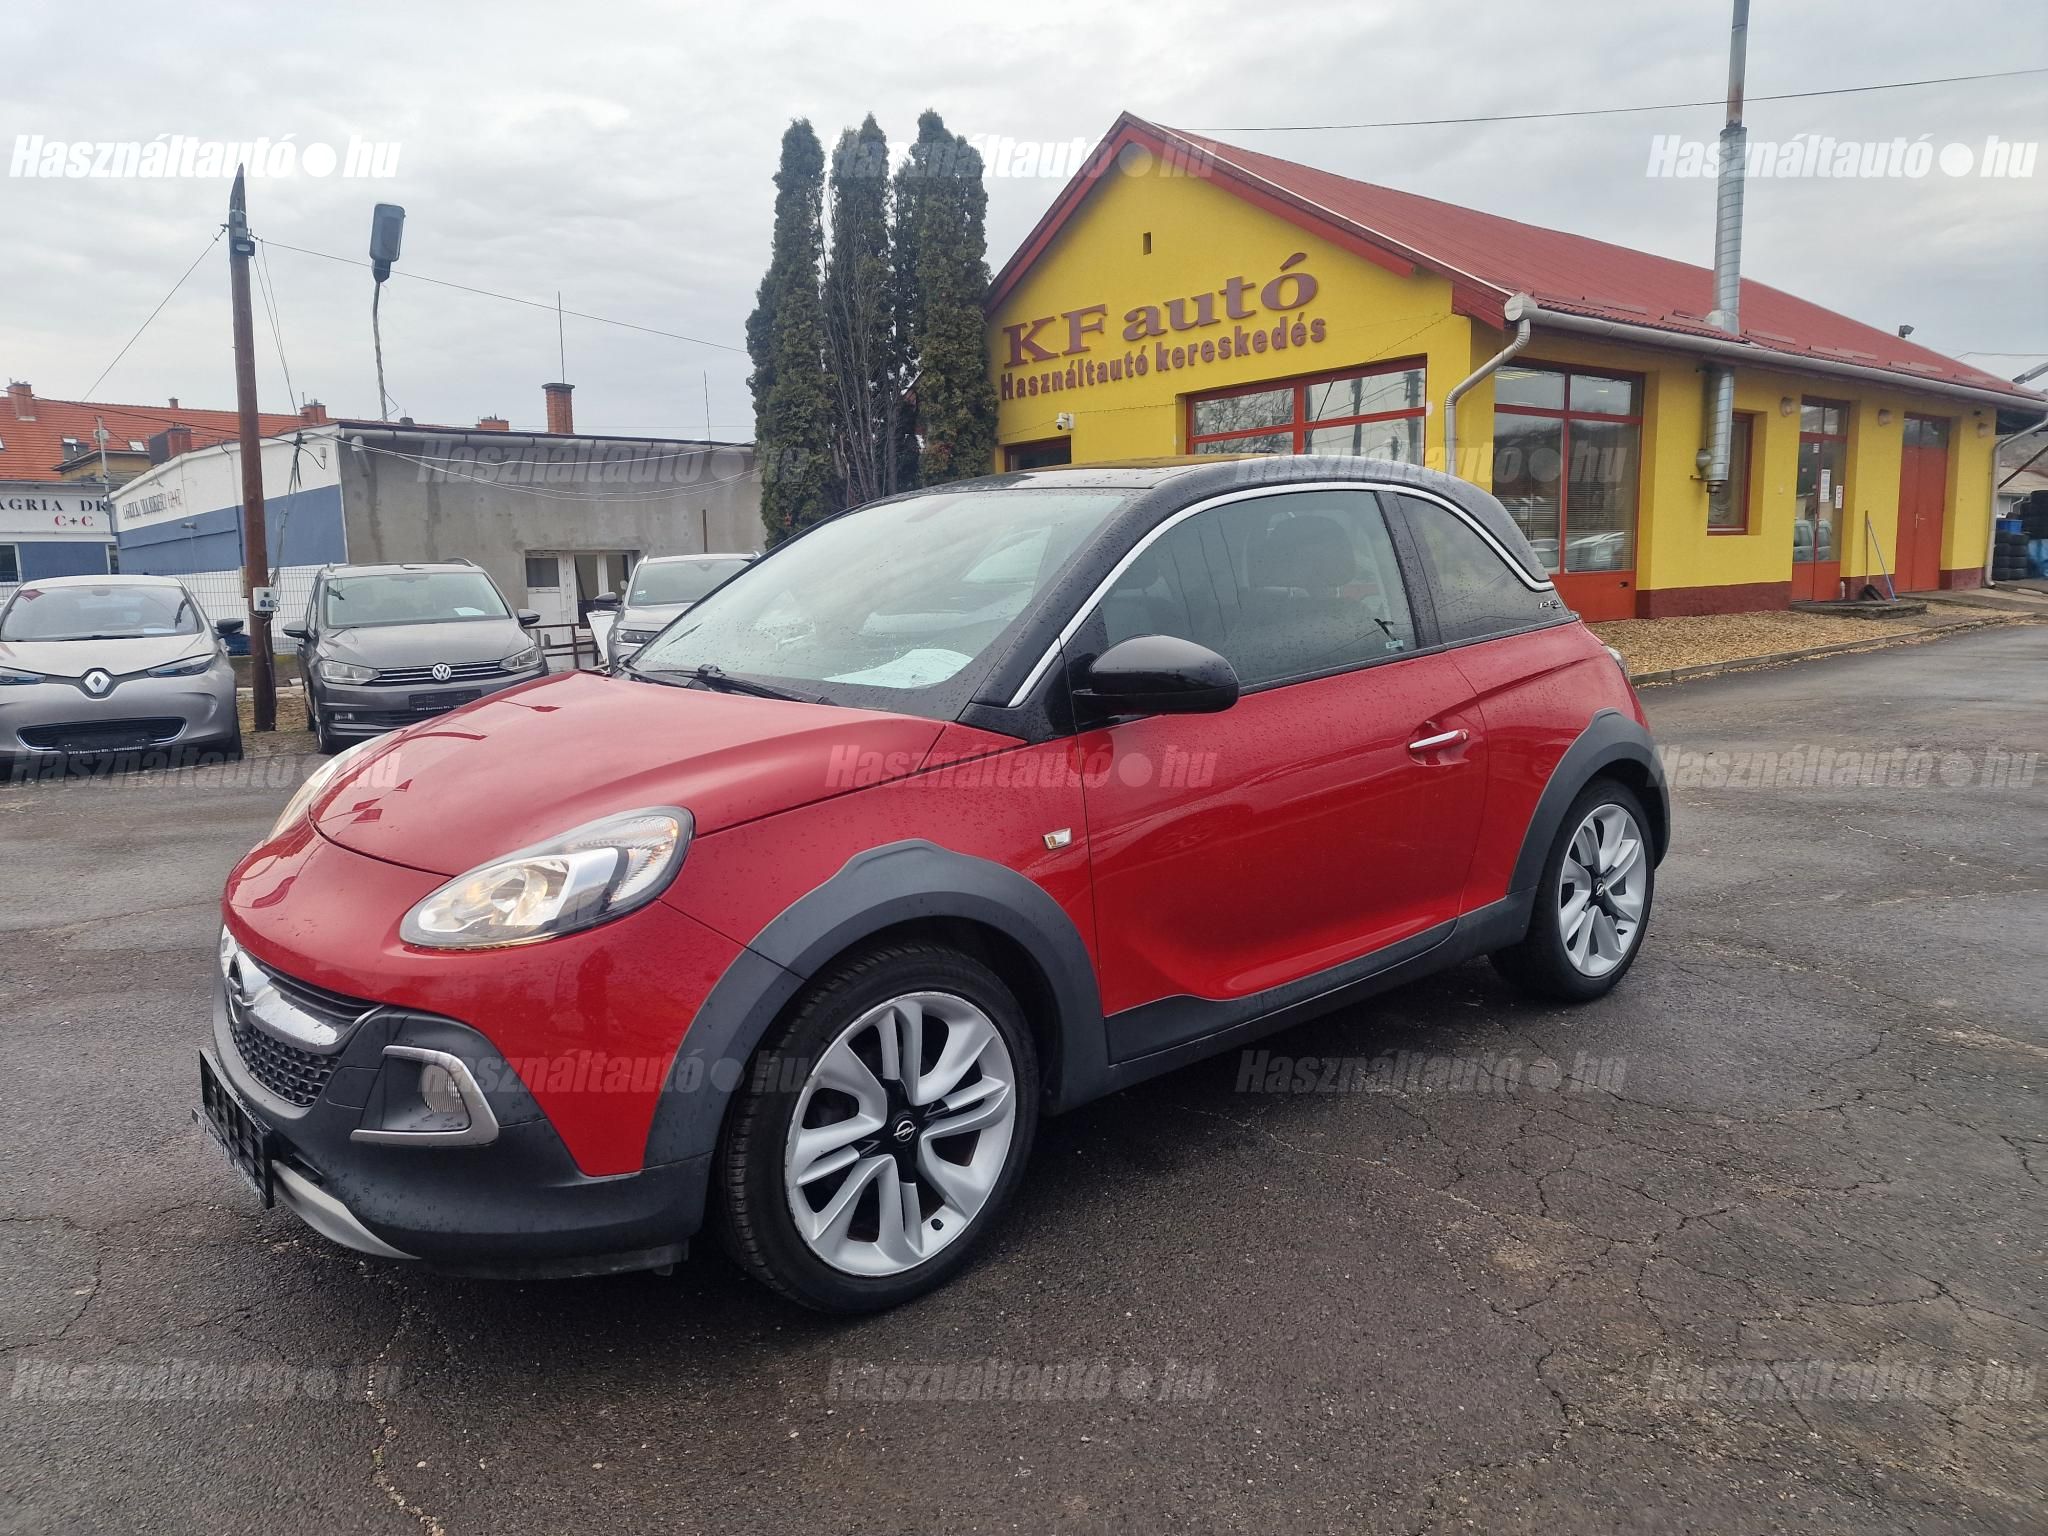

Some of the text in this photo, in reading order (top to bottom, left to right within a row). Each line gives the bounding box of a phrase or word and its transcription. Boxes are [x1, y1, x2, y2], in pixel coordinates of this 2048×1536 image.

[1001, 312, 1327, 401] Használtautó kereskedés
[1002, 252, 1319, 369] KF autó
